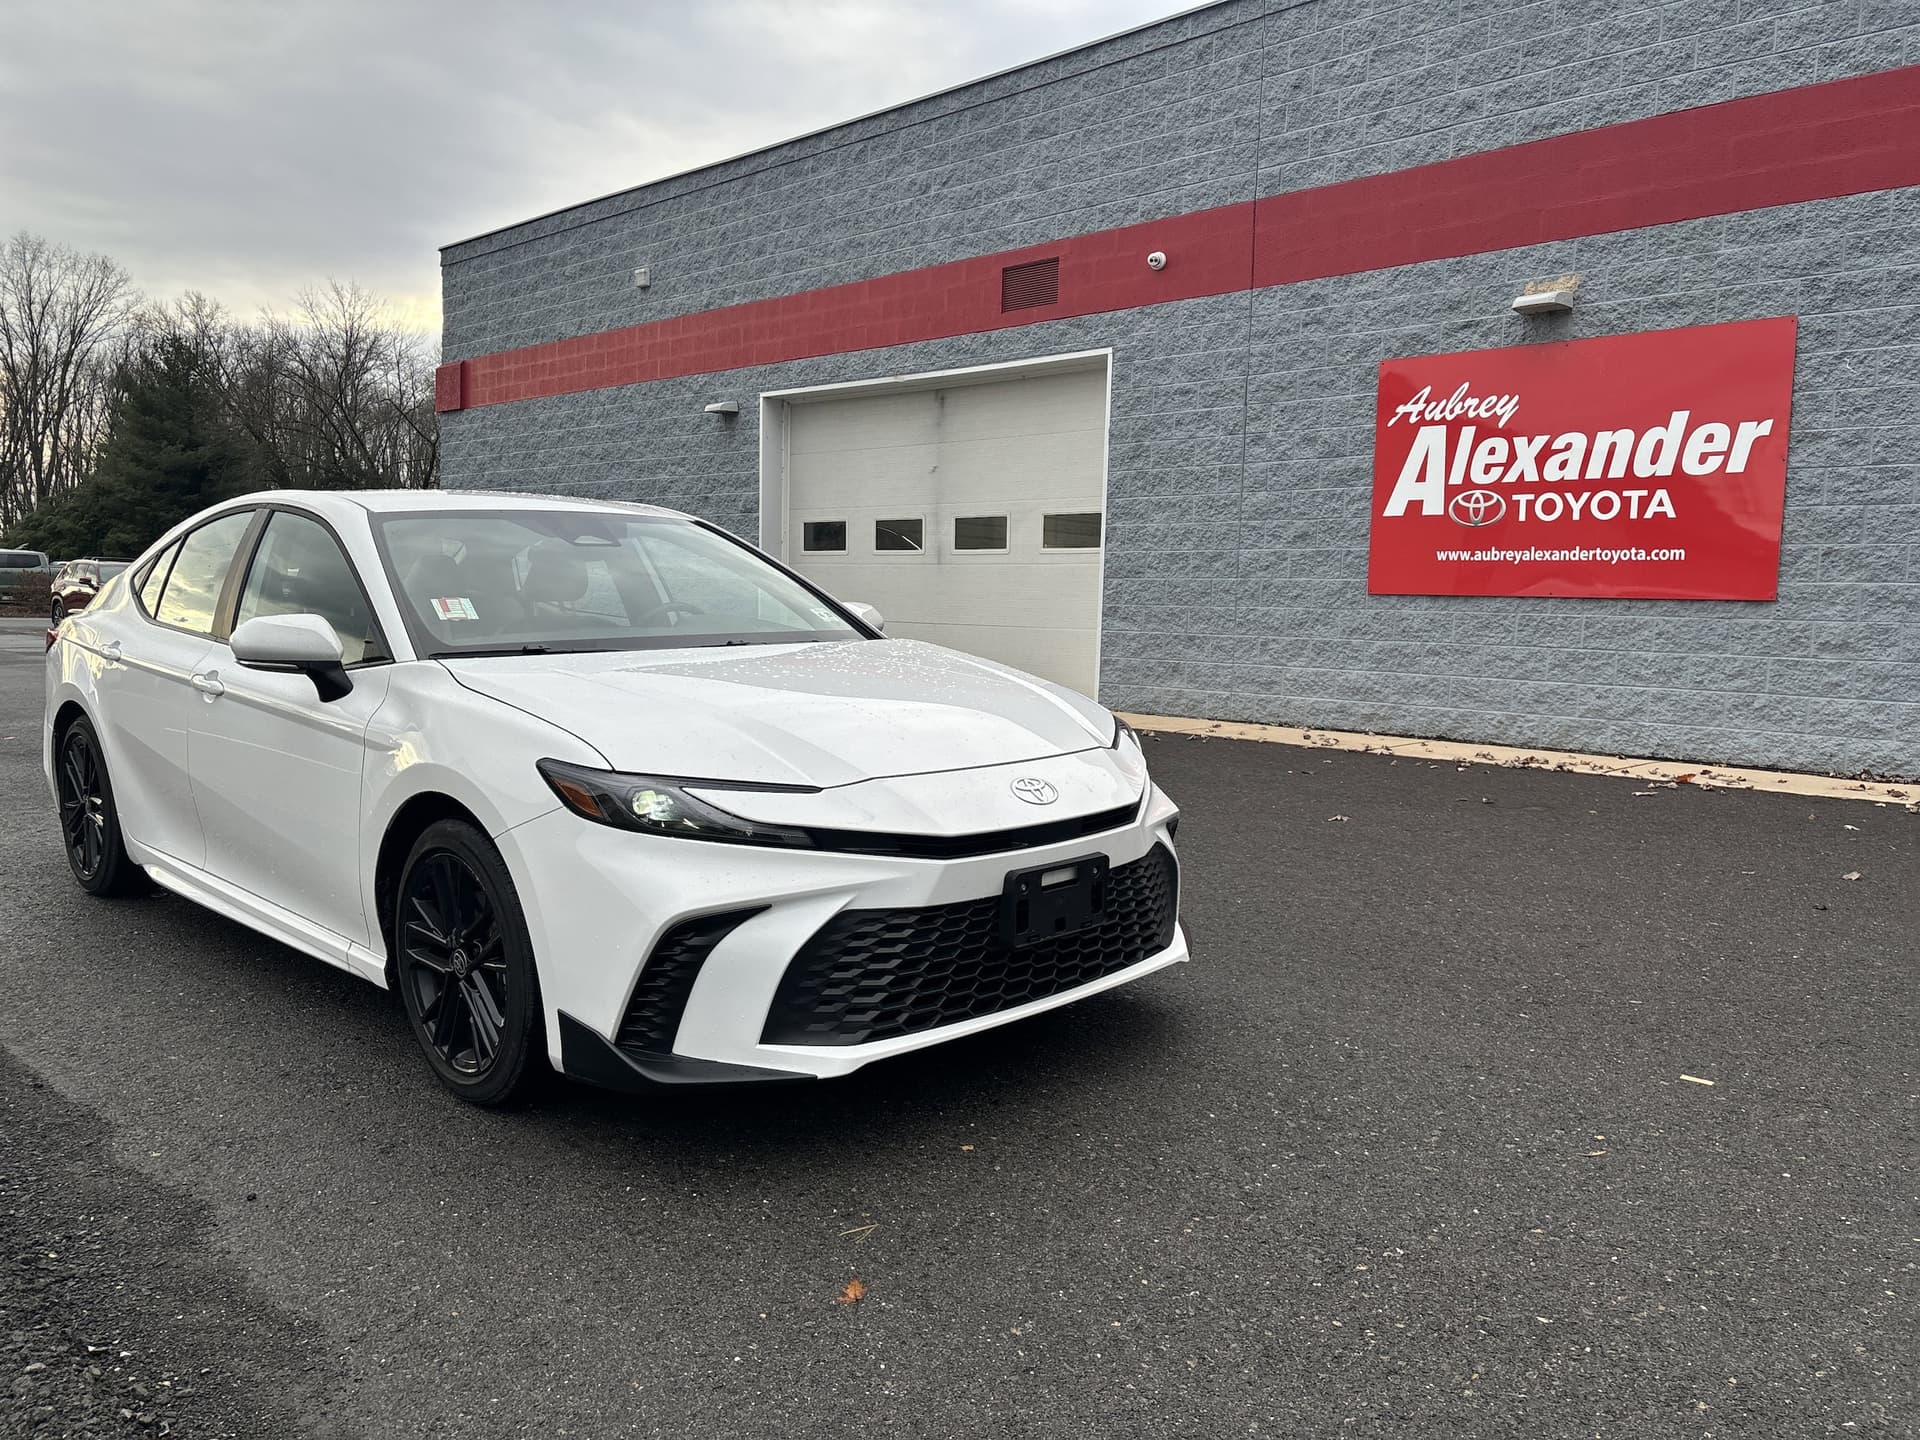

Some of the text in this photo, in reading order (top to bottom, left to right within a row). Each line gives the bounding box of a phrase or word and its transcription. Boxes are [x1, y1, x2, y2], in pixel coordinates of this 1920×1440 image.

[1388, 381, 1519, 428] Aubrey
[1383, 411, 1774, 517] Alexander
[1512, 488, 1677, 522] TOYOTA
[1436, 546, 1686, 565] www.aubreyalexandertoyota.com
